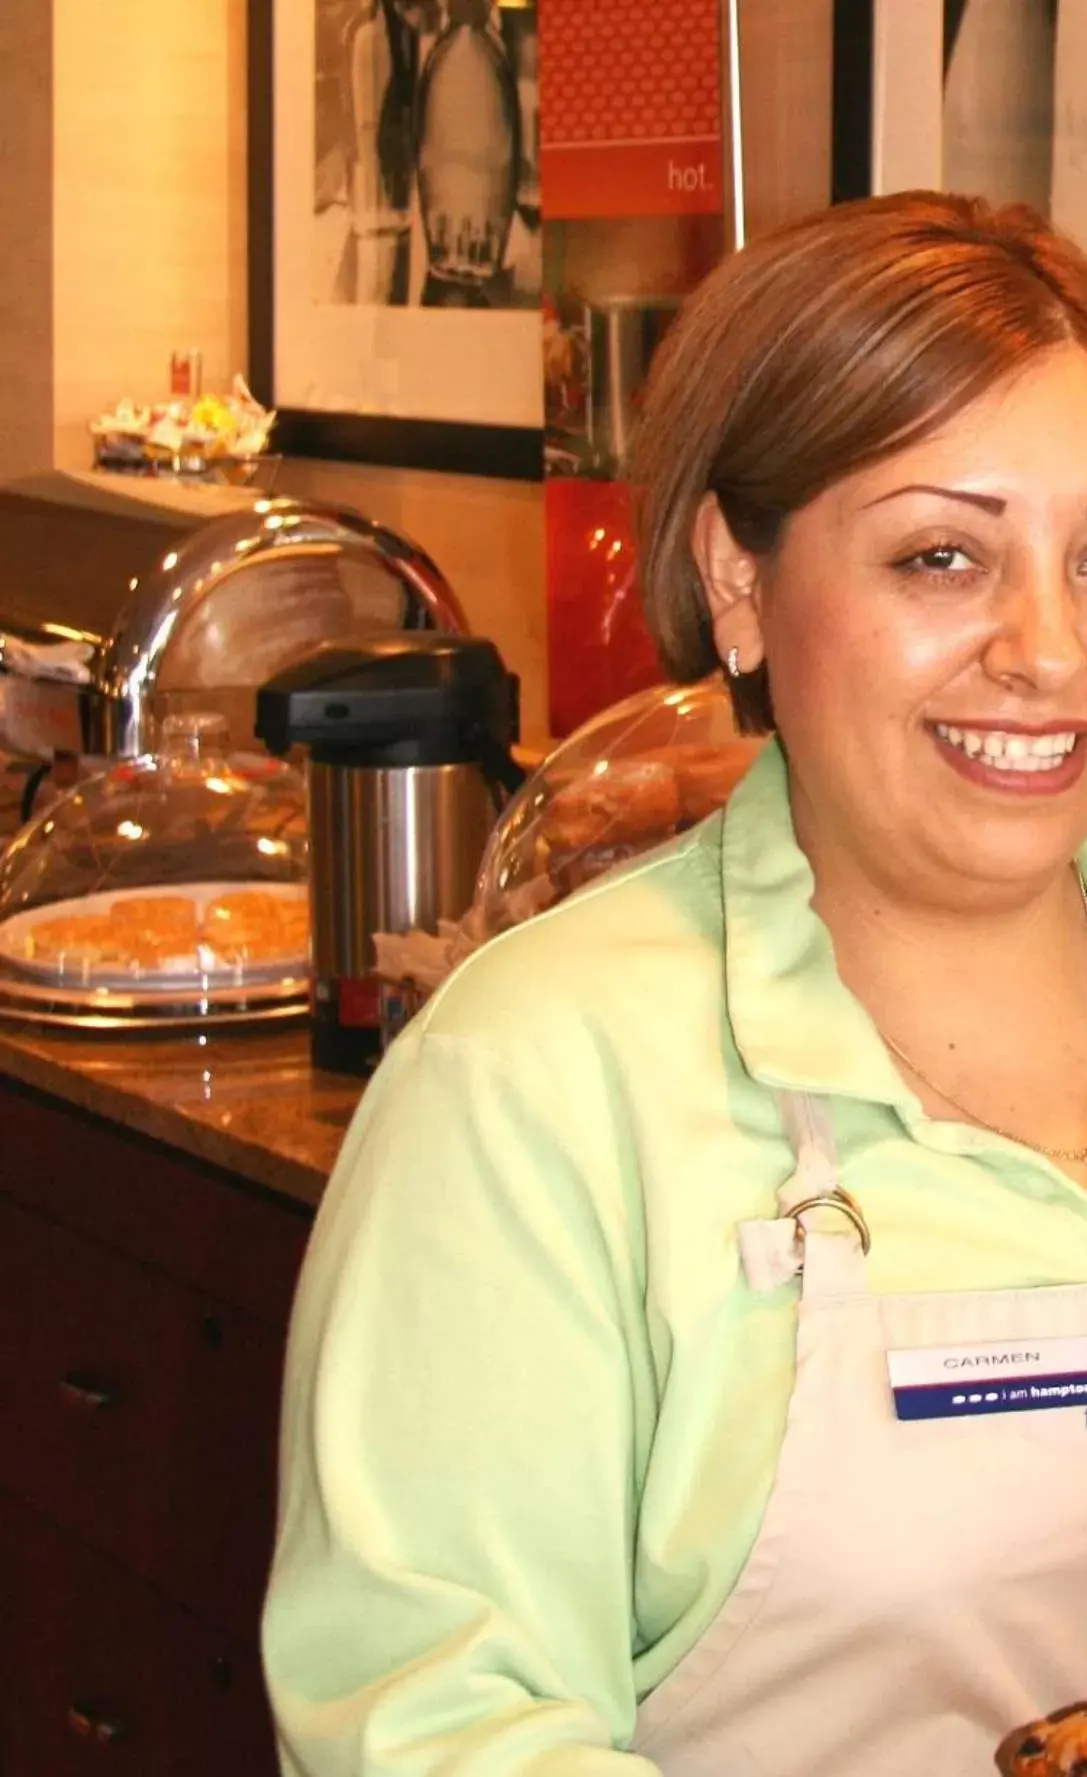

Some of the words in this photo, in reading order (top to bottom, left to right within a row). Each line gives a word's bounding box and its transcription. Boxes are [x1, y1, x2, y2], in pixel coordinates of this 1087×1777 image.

[667, 160, 714, 192] hot.
[943, 1352, 1041, 1369] CARMEN
[1009, 1388, 1028, 1400] am
